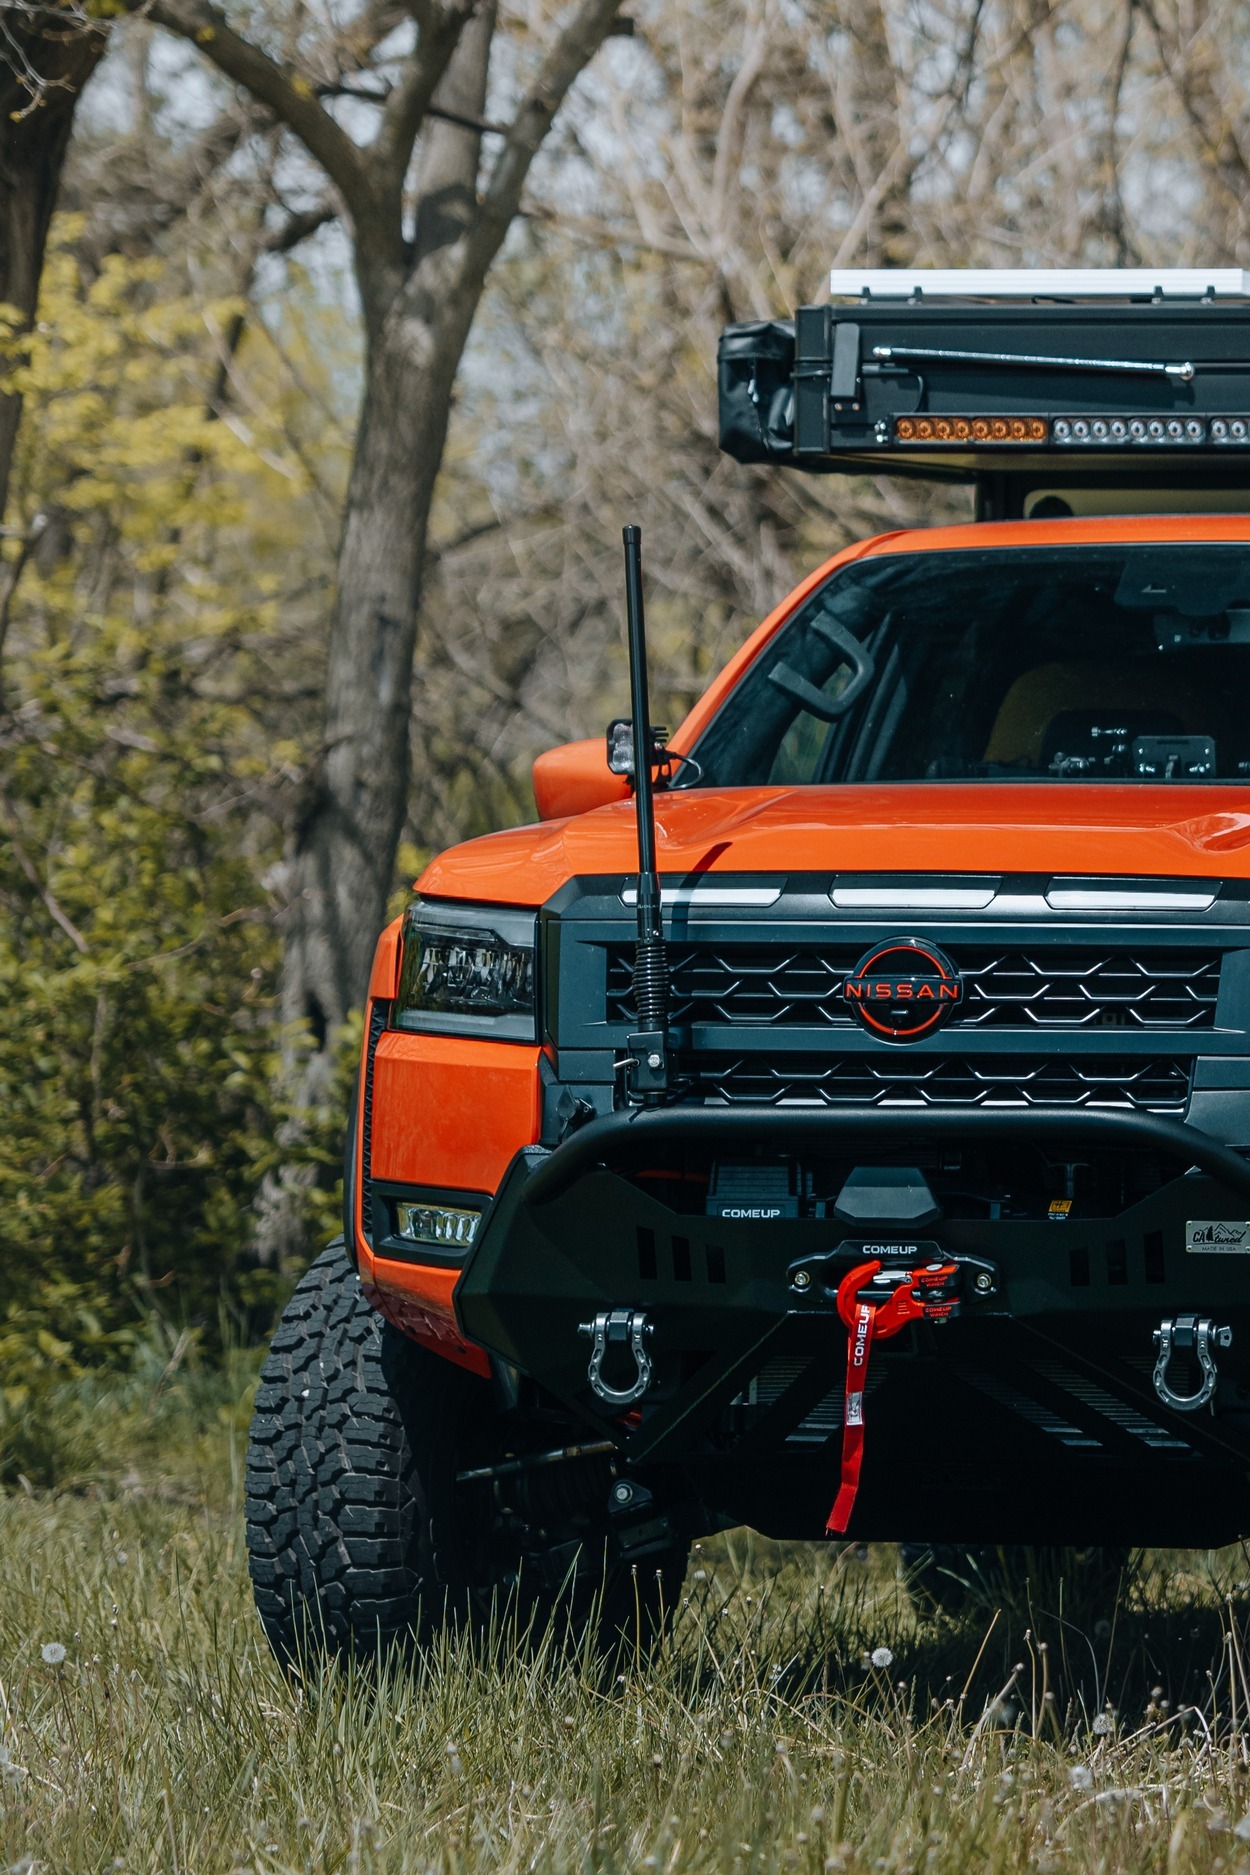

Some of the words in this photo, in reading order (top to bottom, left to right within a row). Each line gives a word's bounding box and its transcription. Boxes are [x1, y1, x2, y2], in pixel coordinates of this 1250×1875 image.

[846, 983, 958, 999] NISSAN
[721, 1209, 781, 1218] COMEUP
[862, 1245, 917, 1254] COMEUP
[921, 1275, 948, 1283] COMEUP
[853, 1304, 871, 1367] COMEUP
